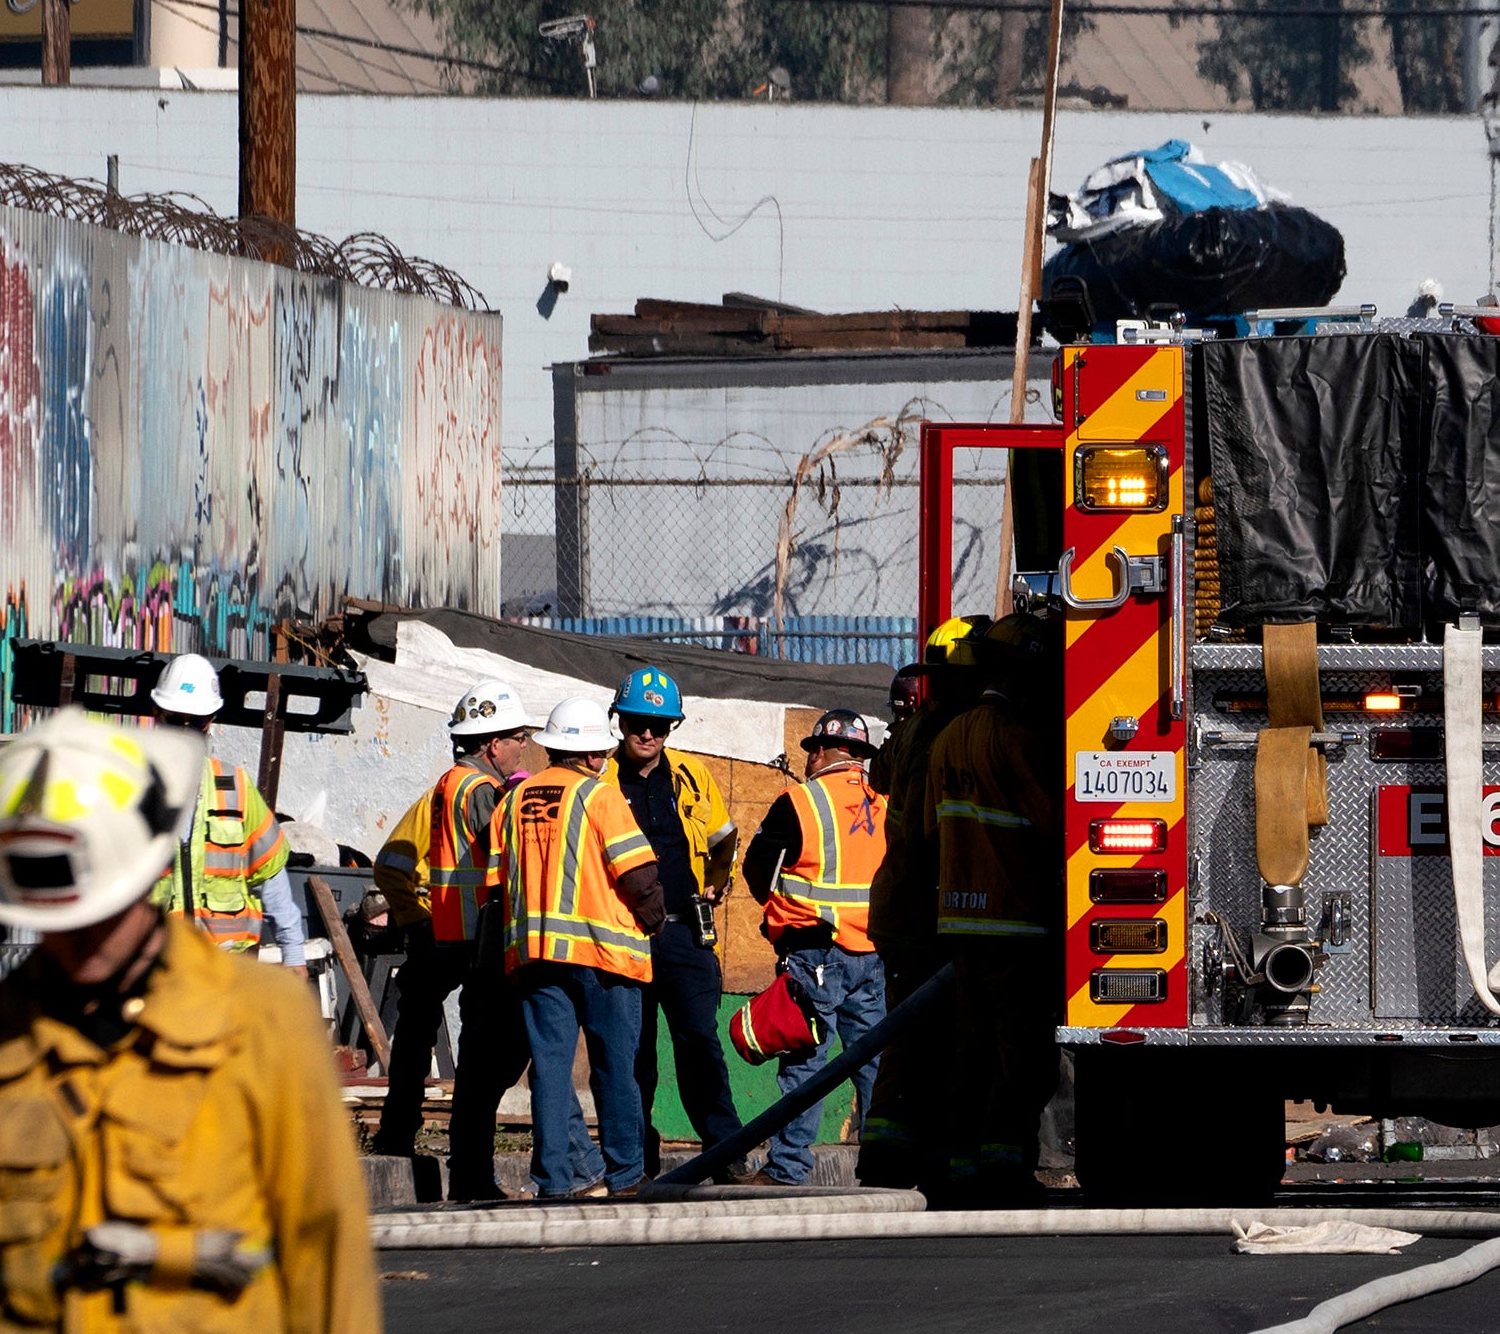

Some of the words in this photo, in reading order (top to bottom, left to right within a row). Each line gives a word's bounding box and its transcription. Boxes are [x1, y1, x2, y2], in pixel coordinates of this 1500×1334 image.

[1099, 759, 1112, 768] CA
[1116, 759, 1151, 768] EXEMPT
[1082, 770, 1168, 795] 1407034
